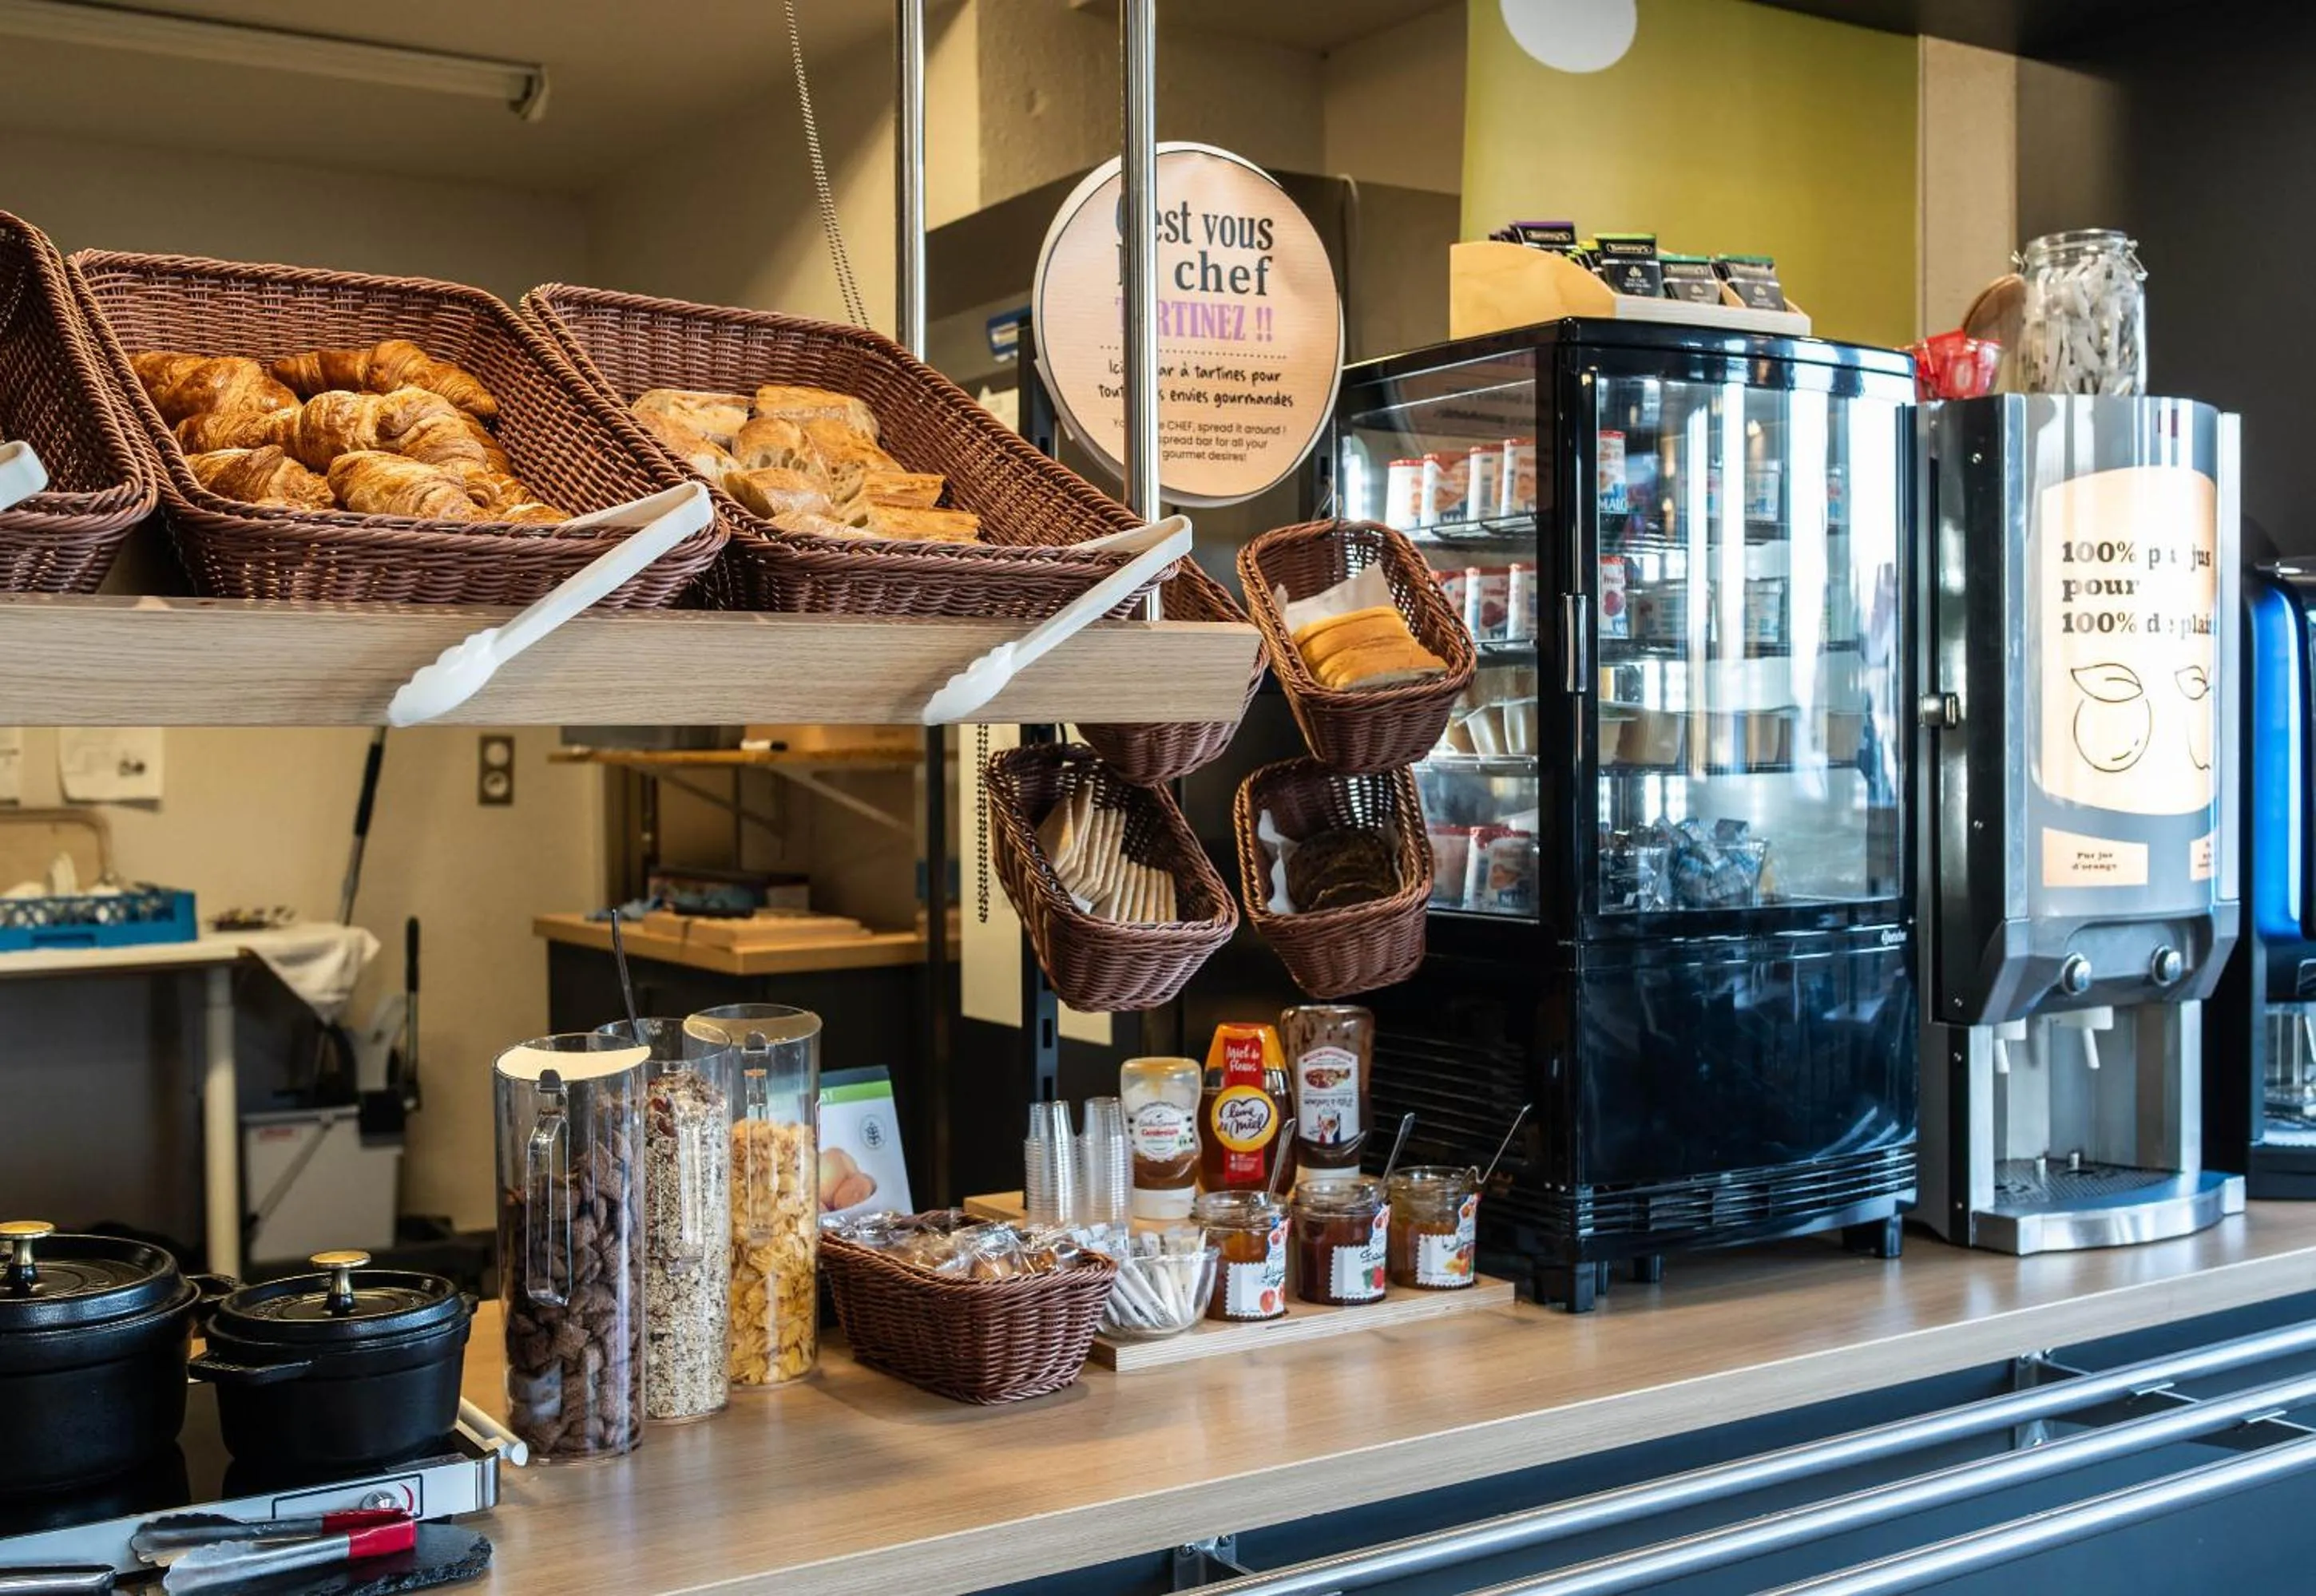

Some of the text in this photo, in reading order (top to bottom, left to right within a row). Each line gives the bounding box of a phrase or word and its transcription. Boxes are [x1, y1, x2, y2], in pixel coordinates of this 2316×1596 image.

[1202, 212, 1274, 251] vous
[1174, 250, 1273, 296] chef
[1116, 297, 1273, 342] RTINEZ !!
[1158, 366, 1174, 378] ar
[1180, 362, 1190, 378] à
[1194, 364, 1247, 382] tartines
[1251, 370, 1283, 386] pour
[1169, 390, 1209, 404] envies
[1213, 390, 1294, 409] gourmandes
[1197, 423, 1234, 435] spread
[1244, 424, 1280, 436] around
[1162, 449, 1206, 461] gourmet
[1195, 436, 1213, 446] bar
[1245, 439, 1268, 451] your
[2062, 541, 2136, 564] 100%
[2062, 578, 2140, 603] pour
[2062, 612, 2136, 634] 100%
